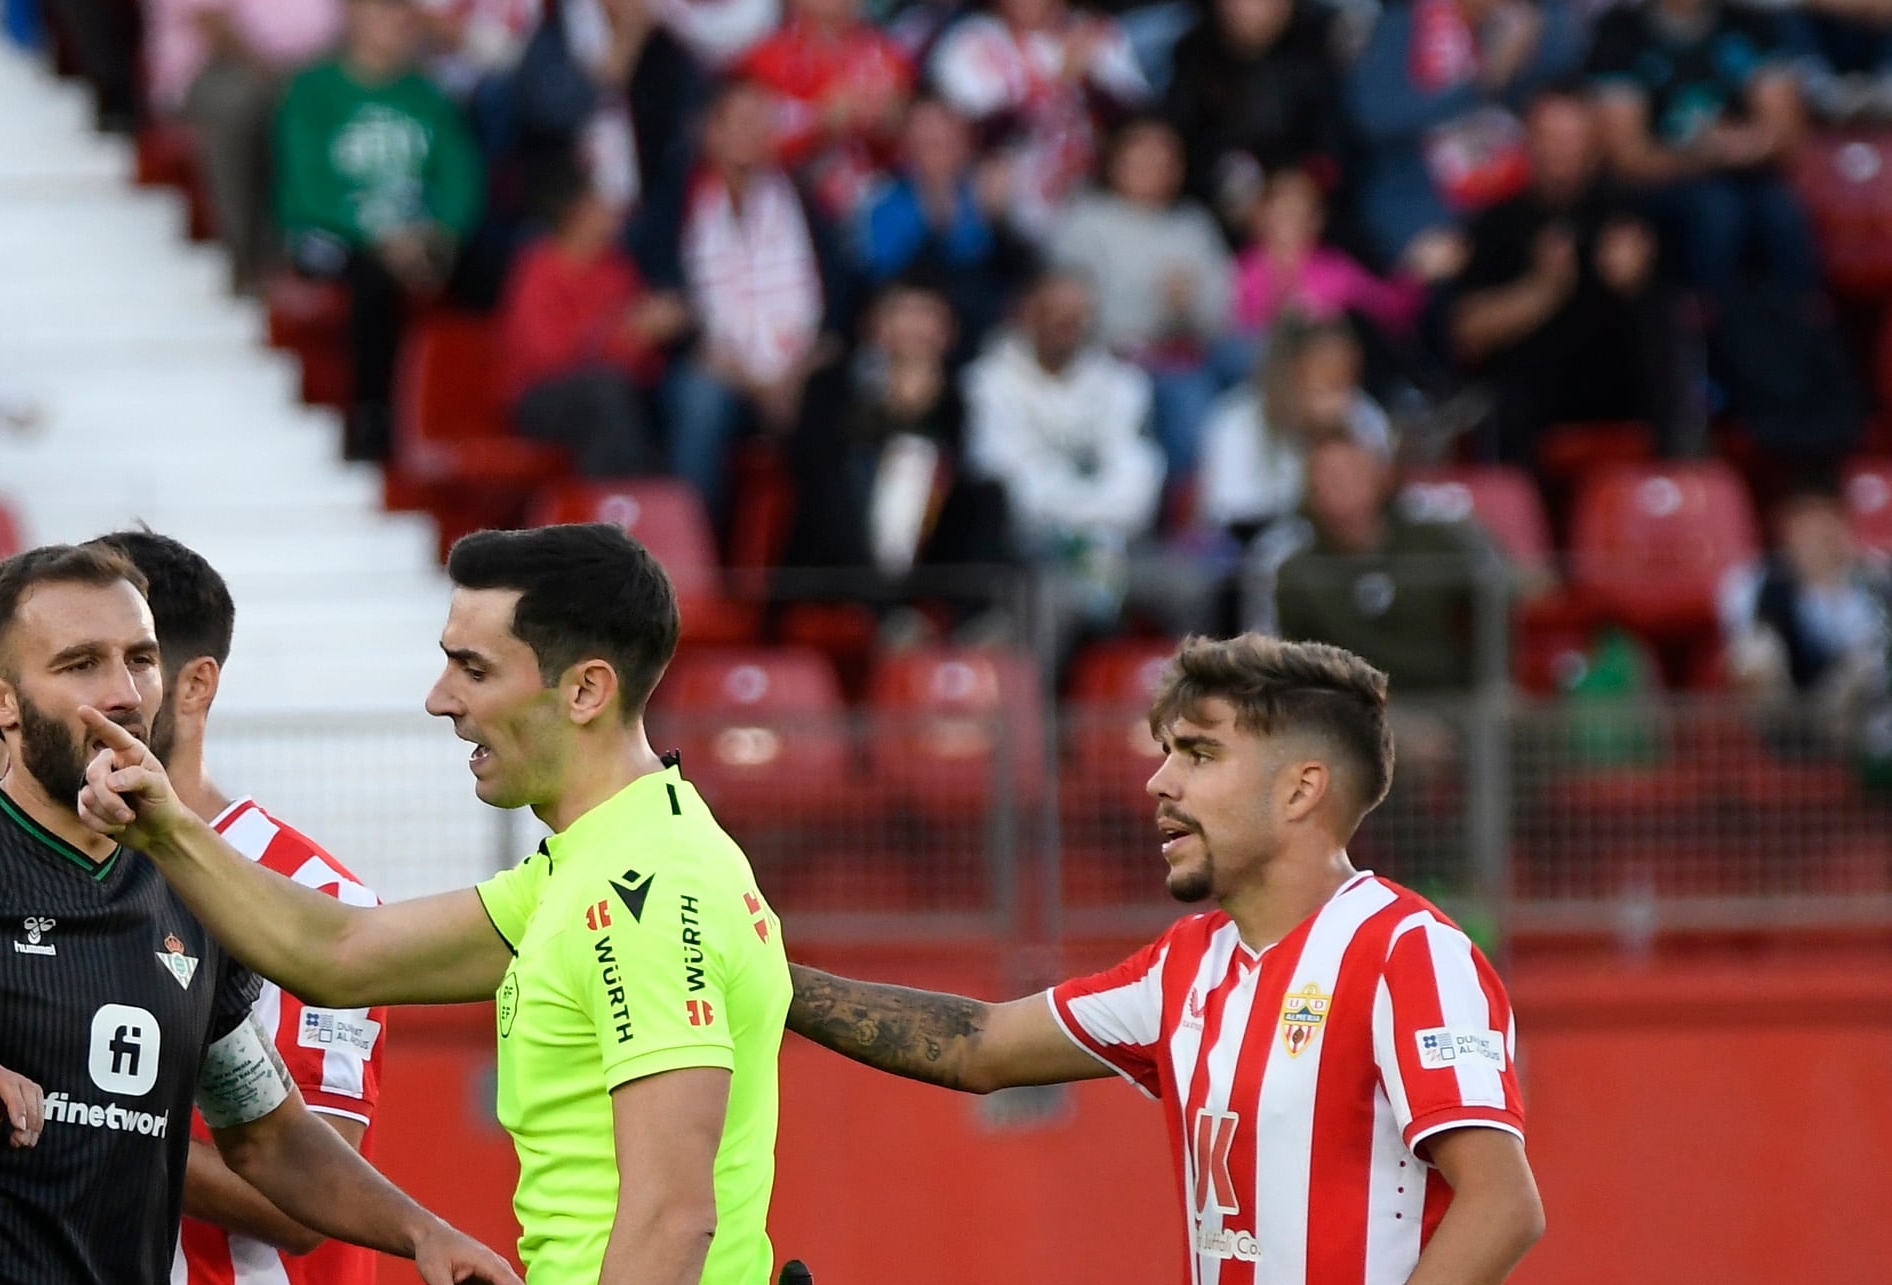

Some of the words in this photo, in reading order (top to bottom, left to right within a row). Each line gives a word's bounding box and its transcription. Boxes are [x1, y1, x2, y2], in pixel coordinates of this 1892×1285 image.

[679, 894, 706, 992] WÜRTH
[594, 935, 634, 1044] WÜRTH
[108, 1025, 142, 1076] fi
[43, 1091, 169, 1139] finetwor
